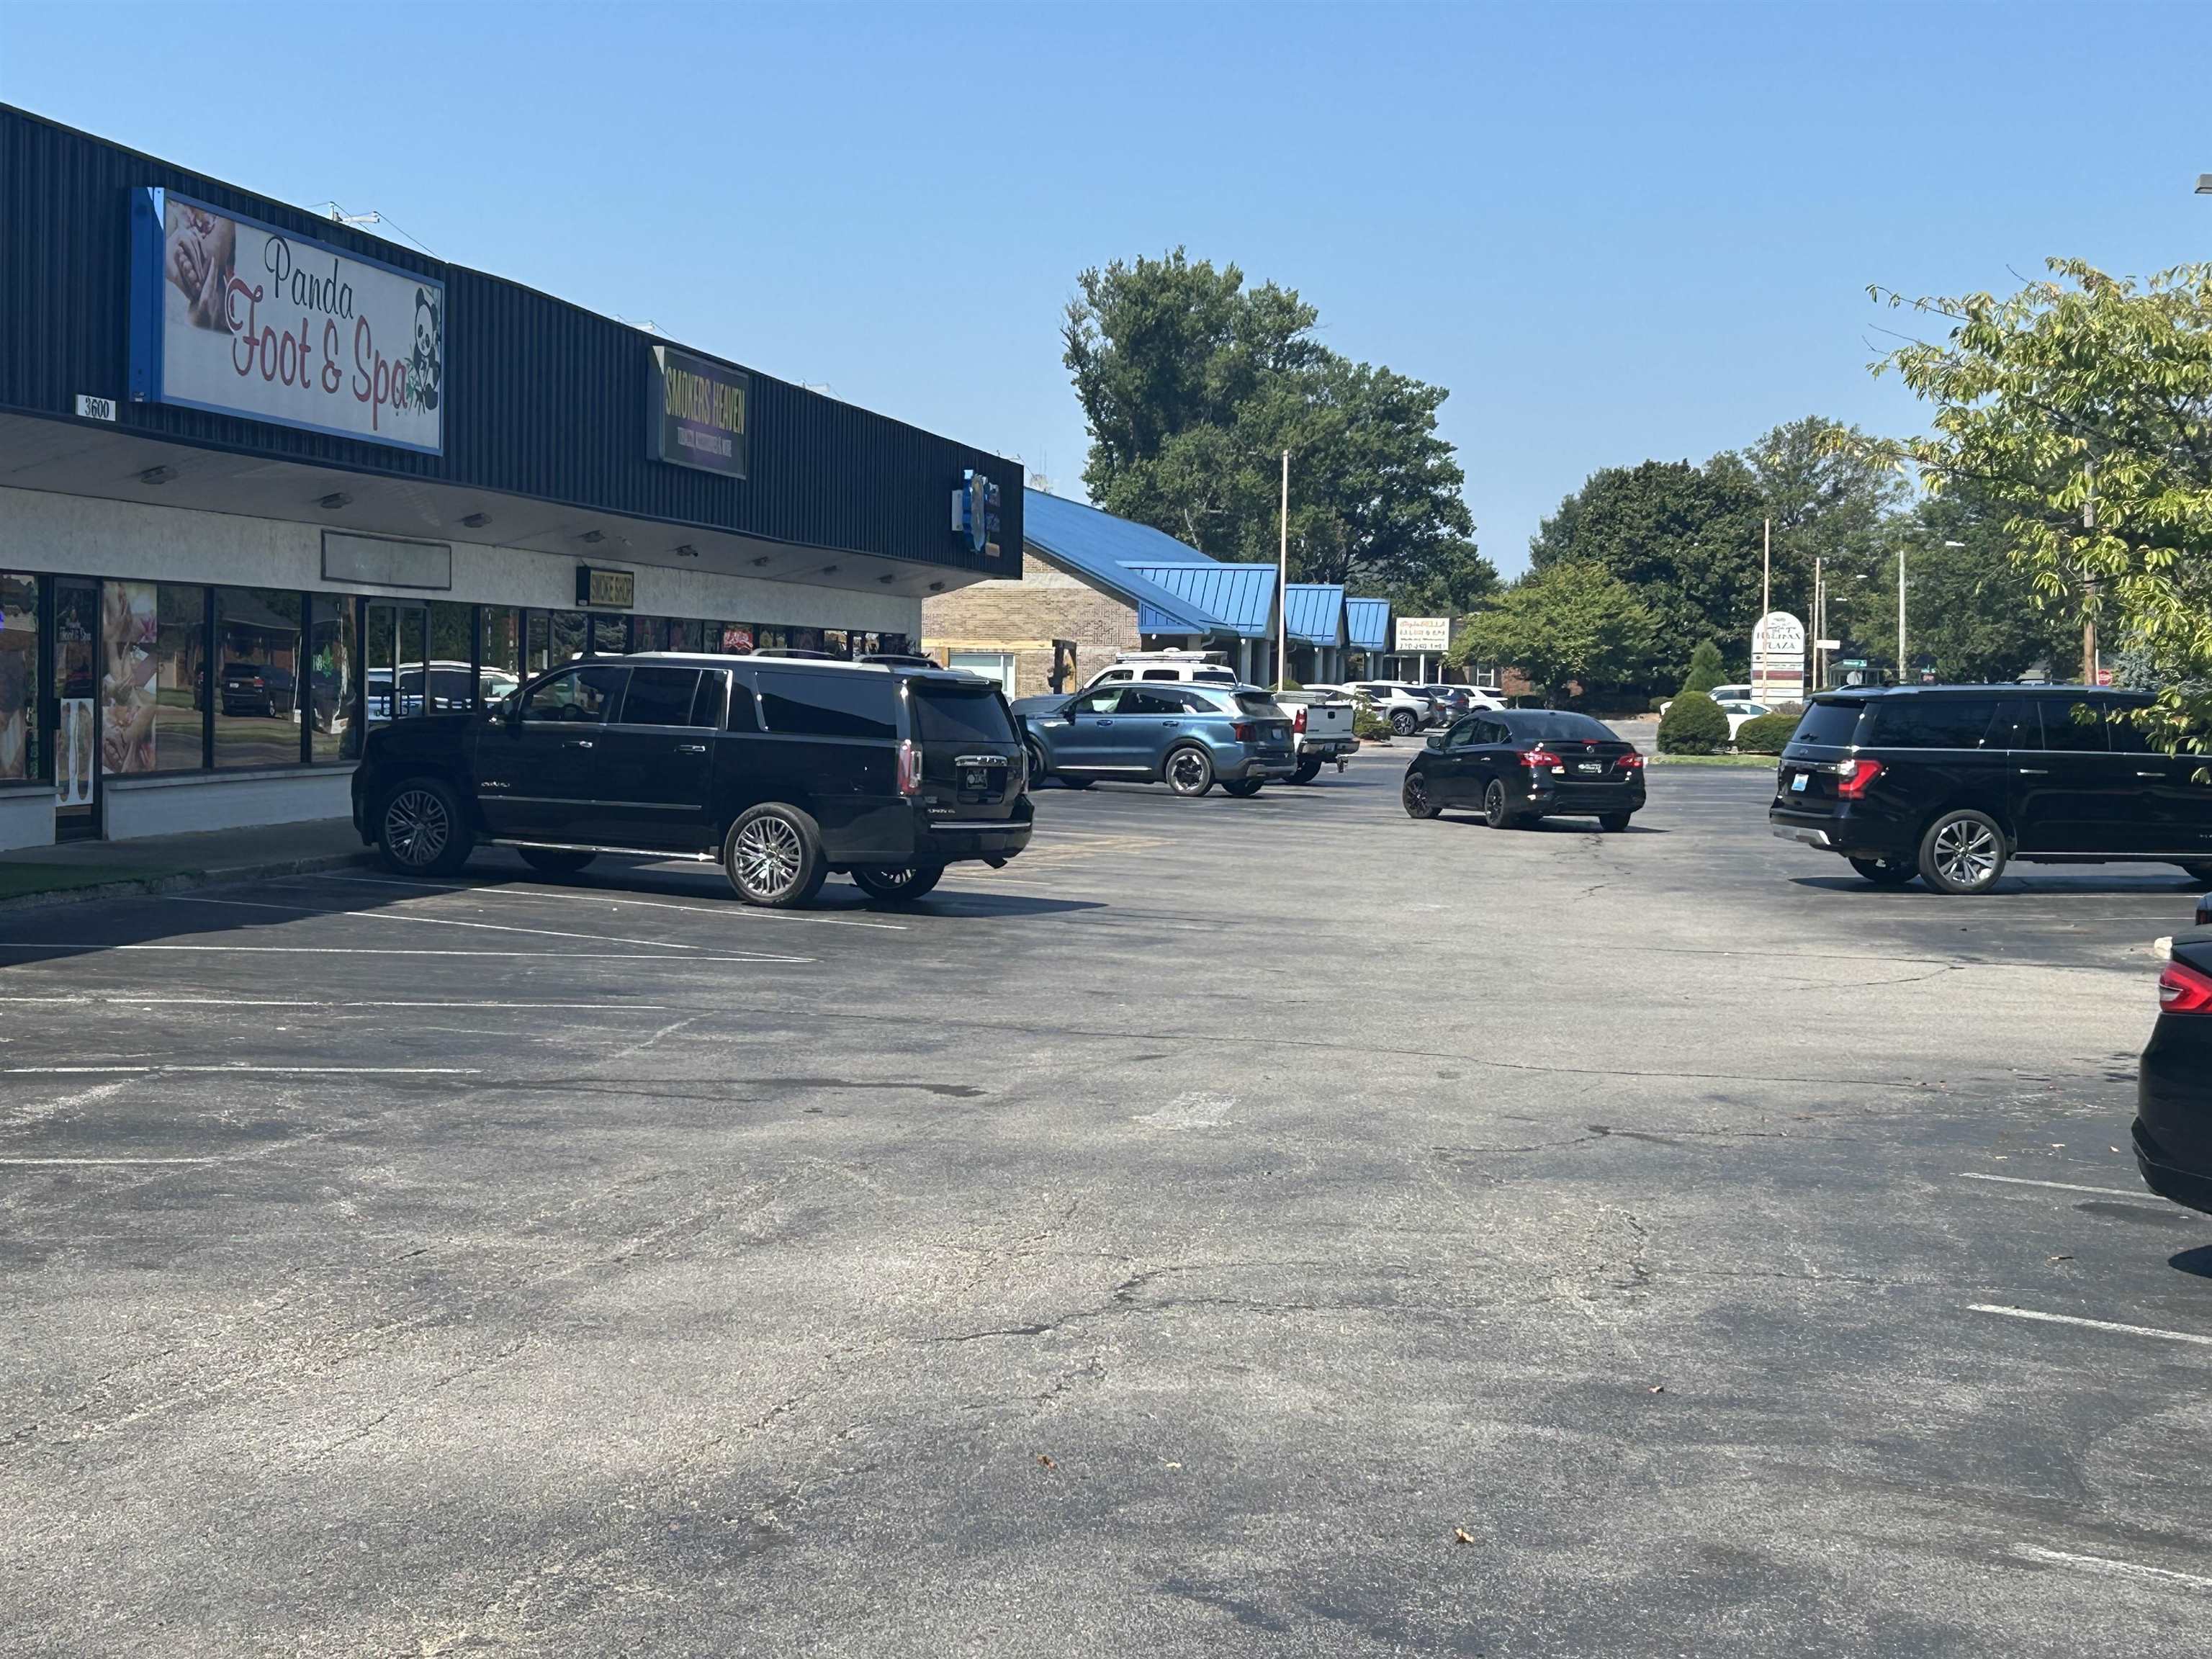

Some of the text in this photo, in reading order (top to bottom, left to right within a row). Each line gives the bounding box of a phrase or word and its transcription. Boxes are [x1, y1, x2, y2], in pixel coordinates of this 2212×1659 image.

[264, 235, 354, 320] Panda
[224, 275, 408, 431] Foot & Spa
[85, 397, 109, 418] 3600
[665, 366, 745, 435] SMOKERS HEAVEN
